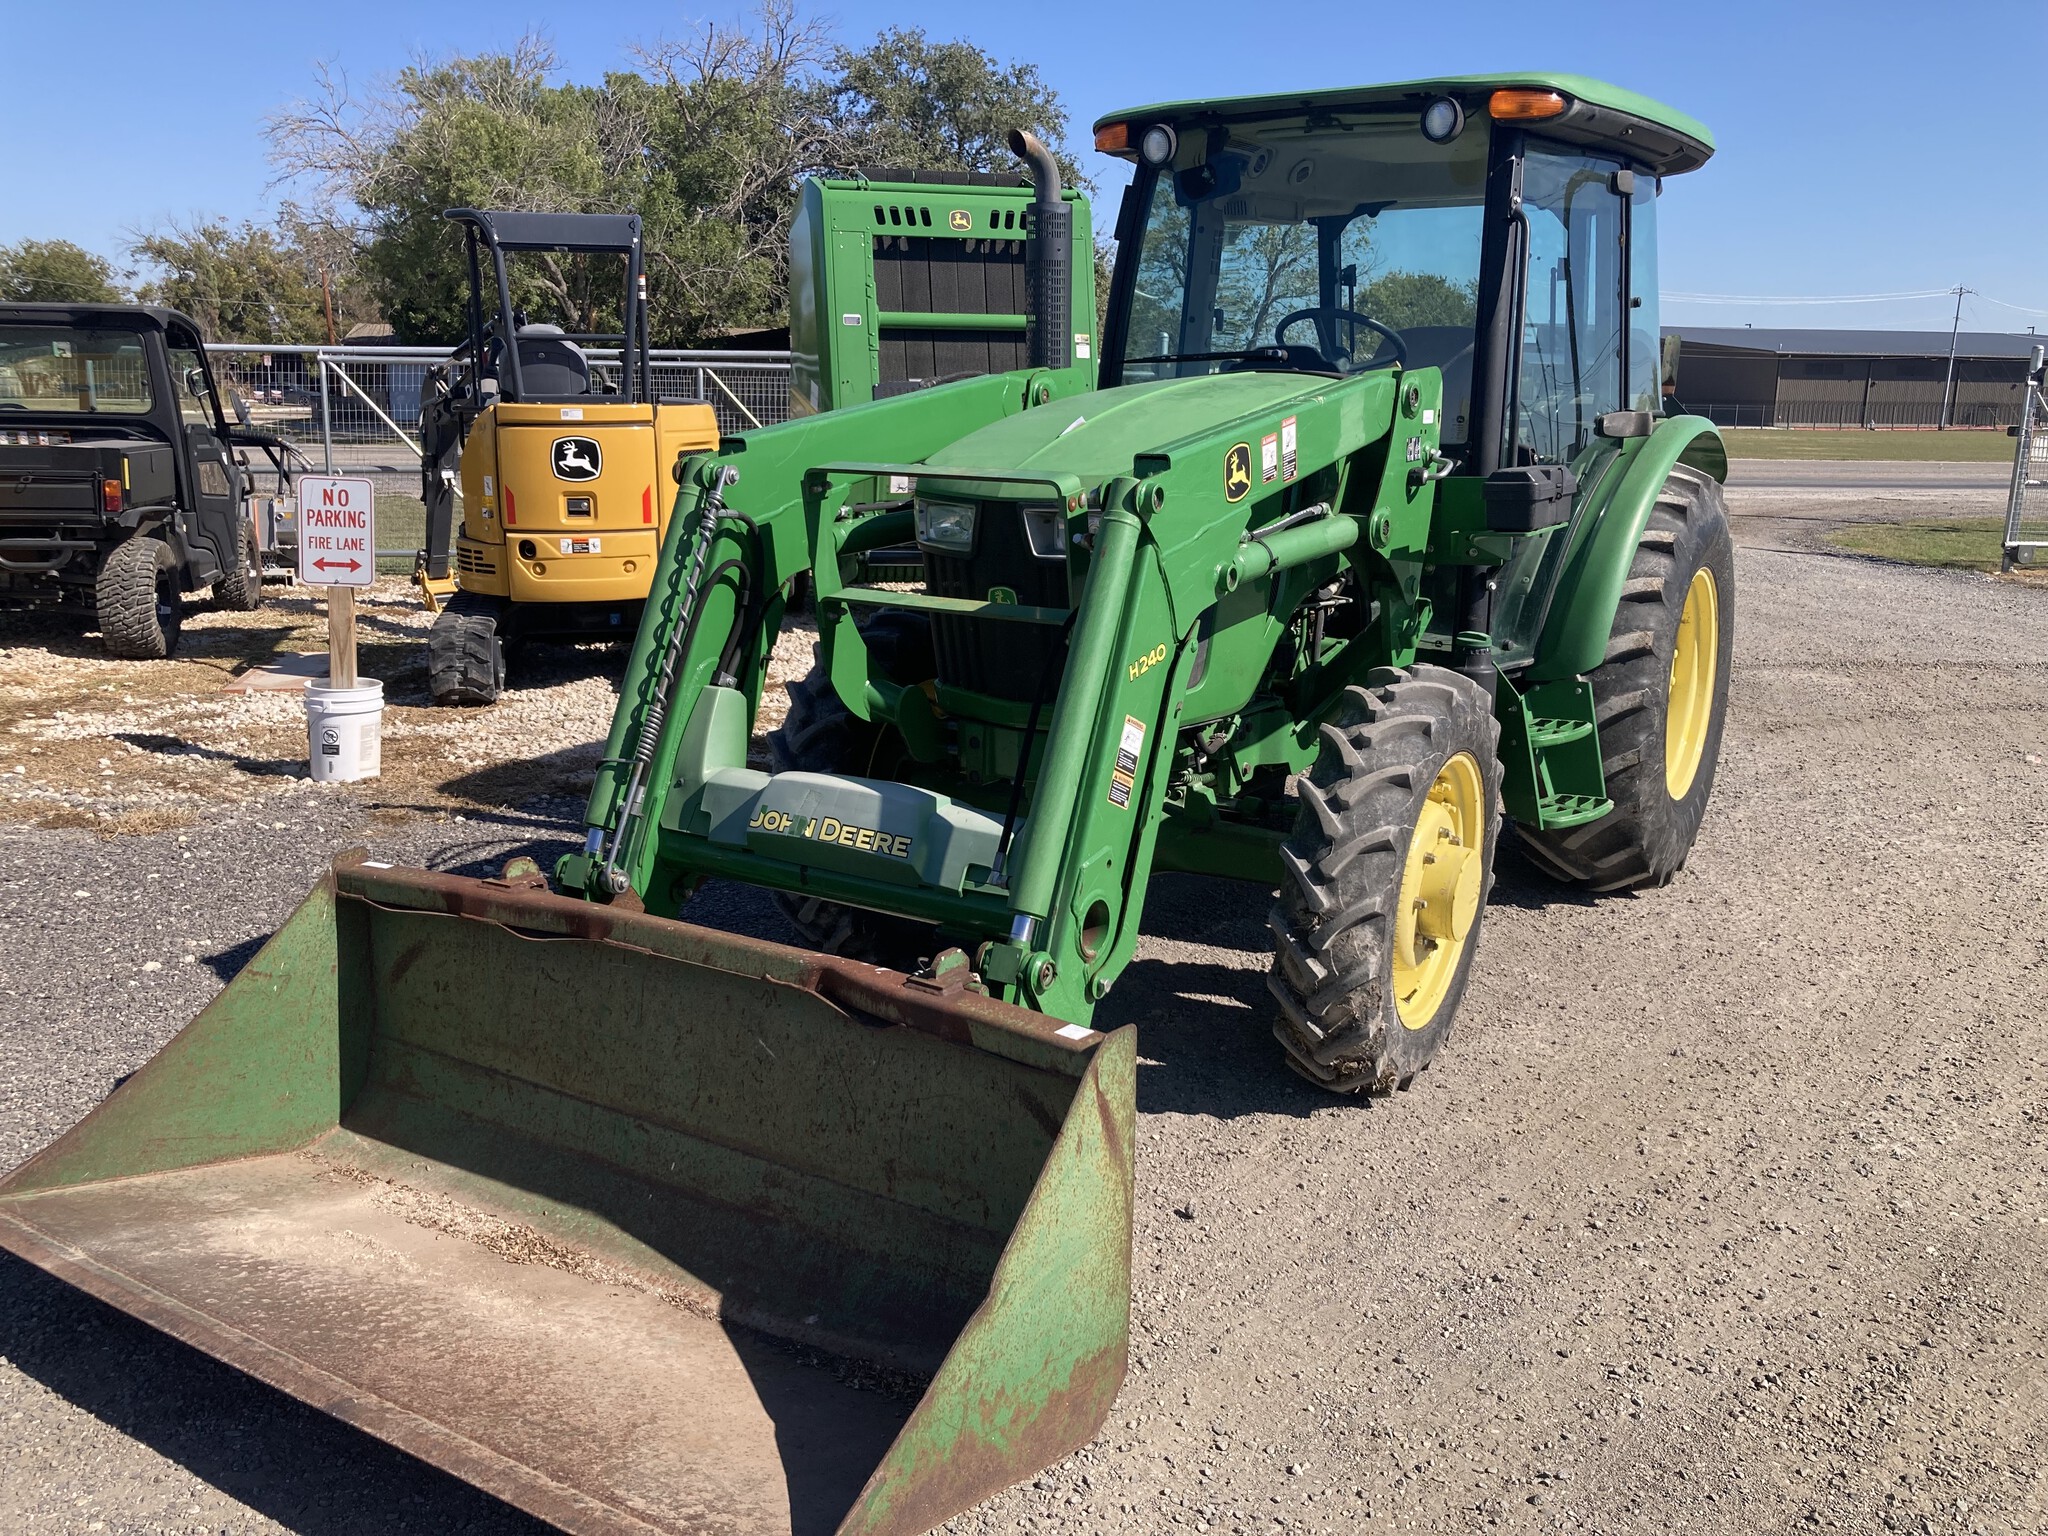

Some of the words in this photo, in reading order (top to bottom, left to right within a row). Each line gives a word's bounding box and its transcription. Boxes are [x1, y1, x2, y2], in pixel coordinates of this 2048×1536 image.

[322, 488, 350, 507] NO
[306, 508, 366, 529] PARKING
[308, 536, 332, 550] FIRE
[336, 537, 365, 551] LANE
[1128, 642, 1167, 683] H240
[817, 816, 912, 858] DEERE
